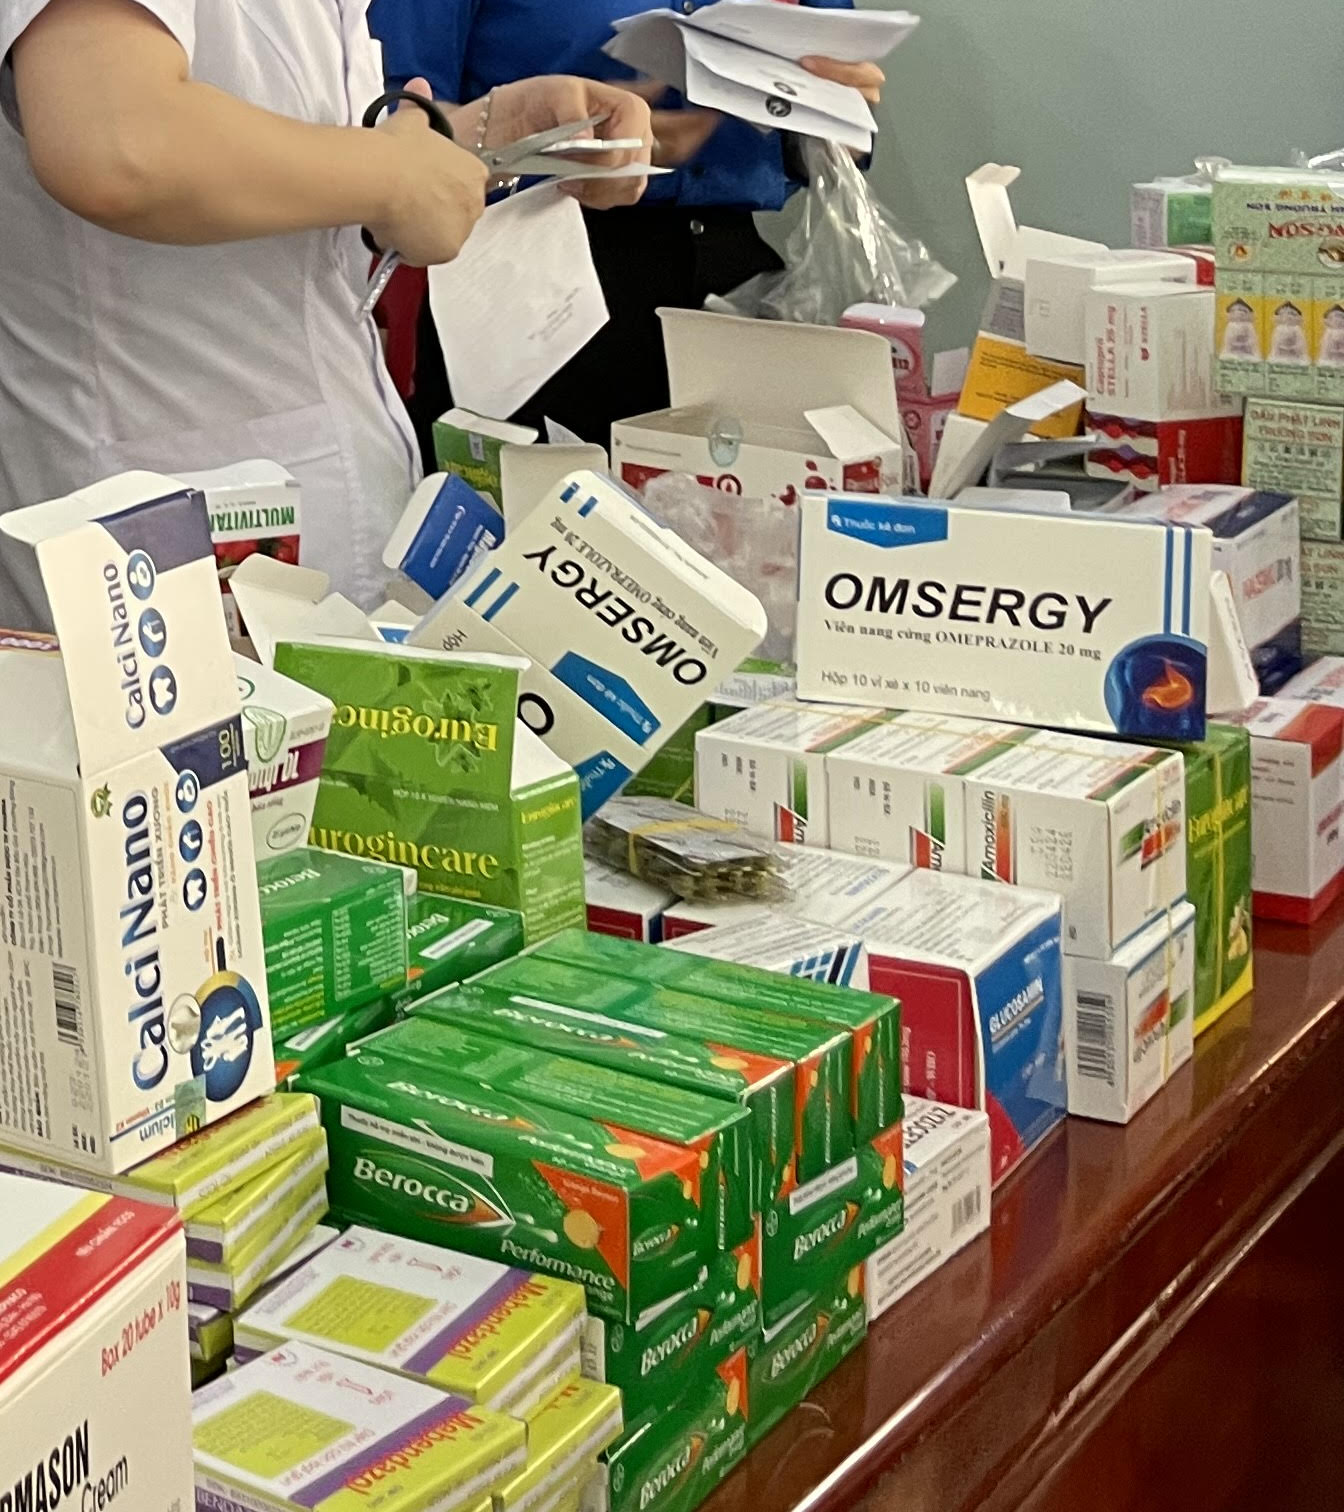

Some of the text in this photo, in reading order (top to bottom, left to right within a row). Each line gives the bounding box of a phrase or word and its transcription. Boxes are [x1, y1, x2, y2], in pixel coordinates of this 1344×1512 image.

[211, 505, 295, 533] MULTIVITA
[523, 545, 707, 685] OMSERGY
[824, 571, 1113, 635] OMSERGY
[101, 559, 148, 731] Calci Nano
[823, 618, 1102, 661] Viên nang cứng OMEPRAZOLE 20 mg
[821, 669, 848, 688] Hộp
[853, 672, 868, 688] 10
[902, 681, 910, 690] x
[915, 679, 931, 693] 10
[960, 686, 991, 703] nang
[308, 824, 500, 880] urogincare
[981, 789, 995, 869] Amoxicillin
[259, 867, 321, 895] Beroc
[118, 792, 172, 1094] Calci Nano
[139, 1114, 179, 1143] lcium
[352, 1156, 471, 1214] Berocca
[501, 1238, 617, 1289] Performance
[100, 1346, 121, 1377] Box
[121, 1322, 134, 1356] 20
[134, 1305, 157, 1341] tube
[447, 1281, 549, 1361] Mebendazol
[344, 1410, 485, 1496] Mebendazol
[81, 1454, 129, 1512] Cream
